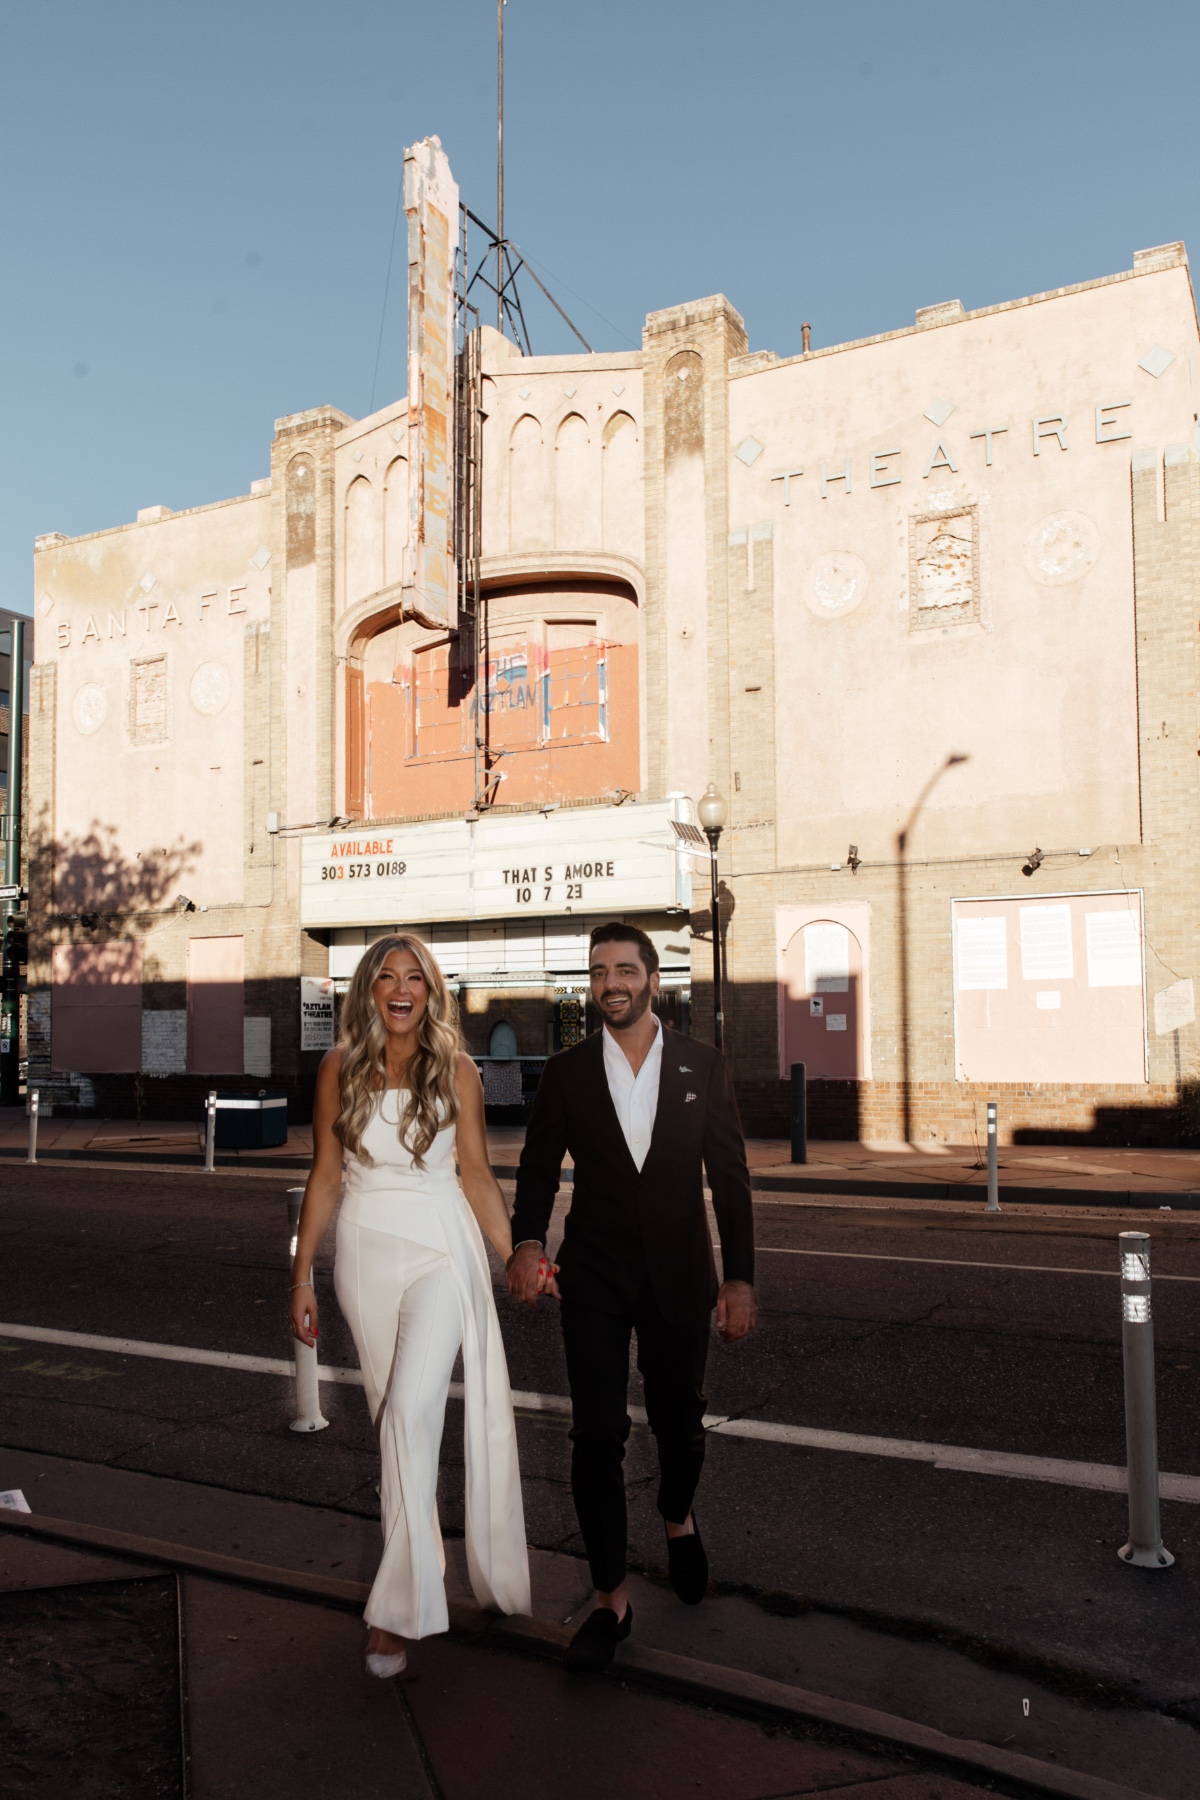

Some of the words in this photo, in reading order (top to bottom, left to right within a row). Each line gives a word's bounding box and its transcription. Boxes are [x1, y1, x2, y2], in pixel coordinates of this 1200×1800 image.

[771, 400, 1133, 507] THEATRE
[56, 602, 182, 649] SANTA
[199, 583, 248, 622] FE
[331, 839, 394, 857] AVAILABLE
[321, 865, 344, 880] 303
[349, 863, 371, 878] 573
[502, 867, 537, 884] THAT
[545, 866, 553, 881] S
[564, 861, 614, 881] AMORE
[516, 887, 531, 903] 10
[543, 886, 552, 901] 7
[304, 1003, 331, 1011] AZTLAN
